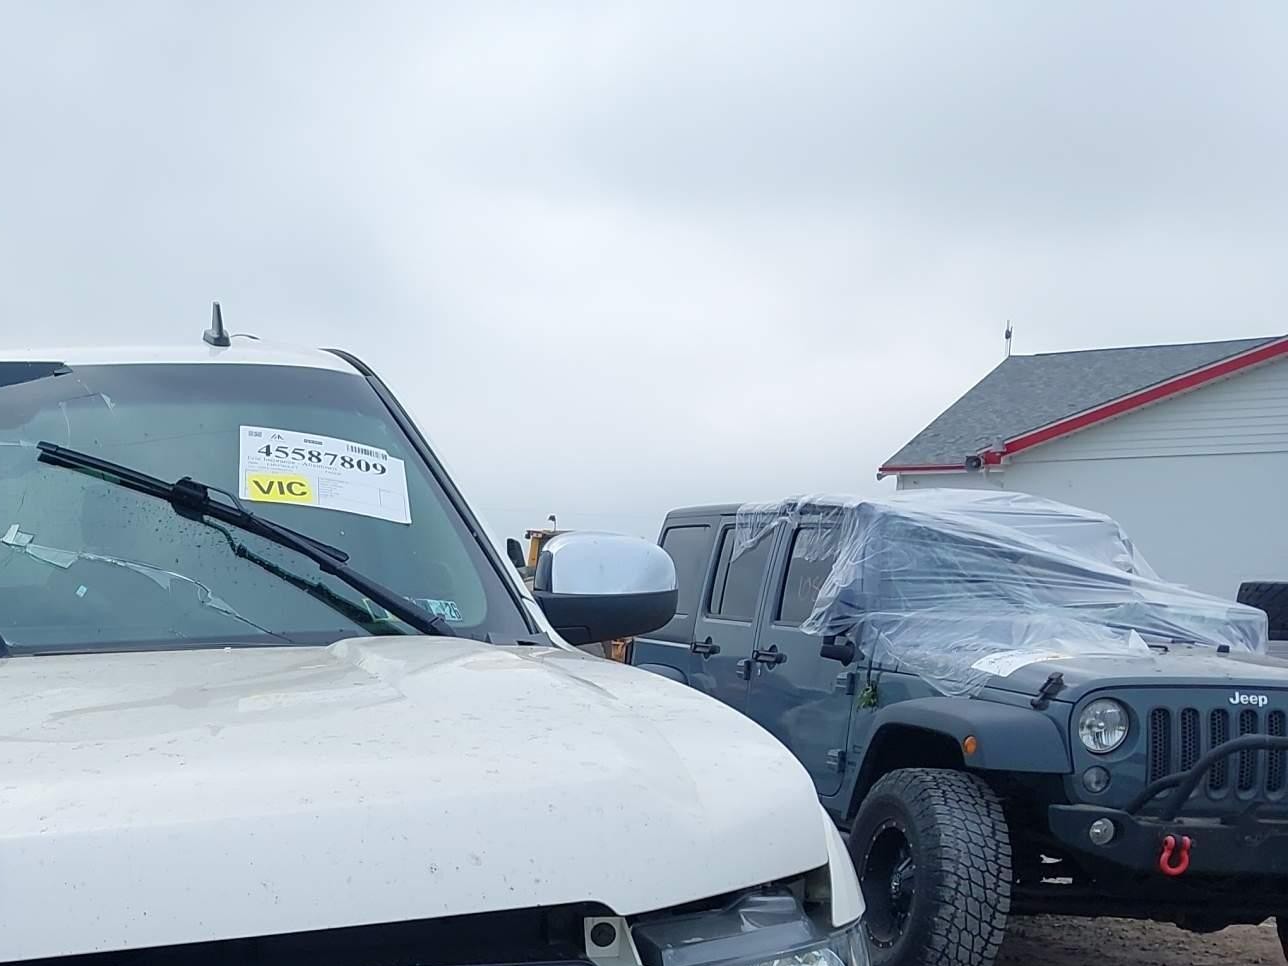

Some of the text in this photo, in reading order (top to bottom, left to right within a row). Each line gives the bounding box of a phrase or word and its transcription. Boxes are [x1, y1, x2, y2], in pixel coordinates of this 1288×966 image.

[257, 444, 387, 476] 45587809
[253, 480, 308, 497] VIC
[1229, 691, 1268, 708] Jeep
